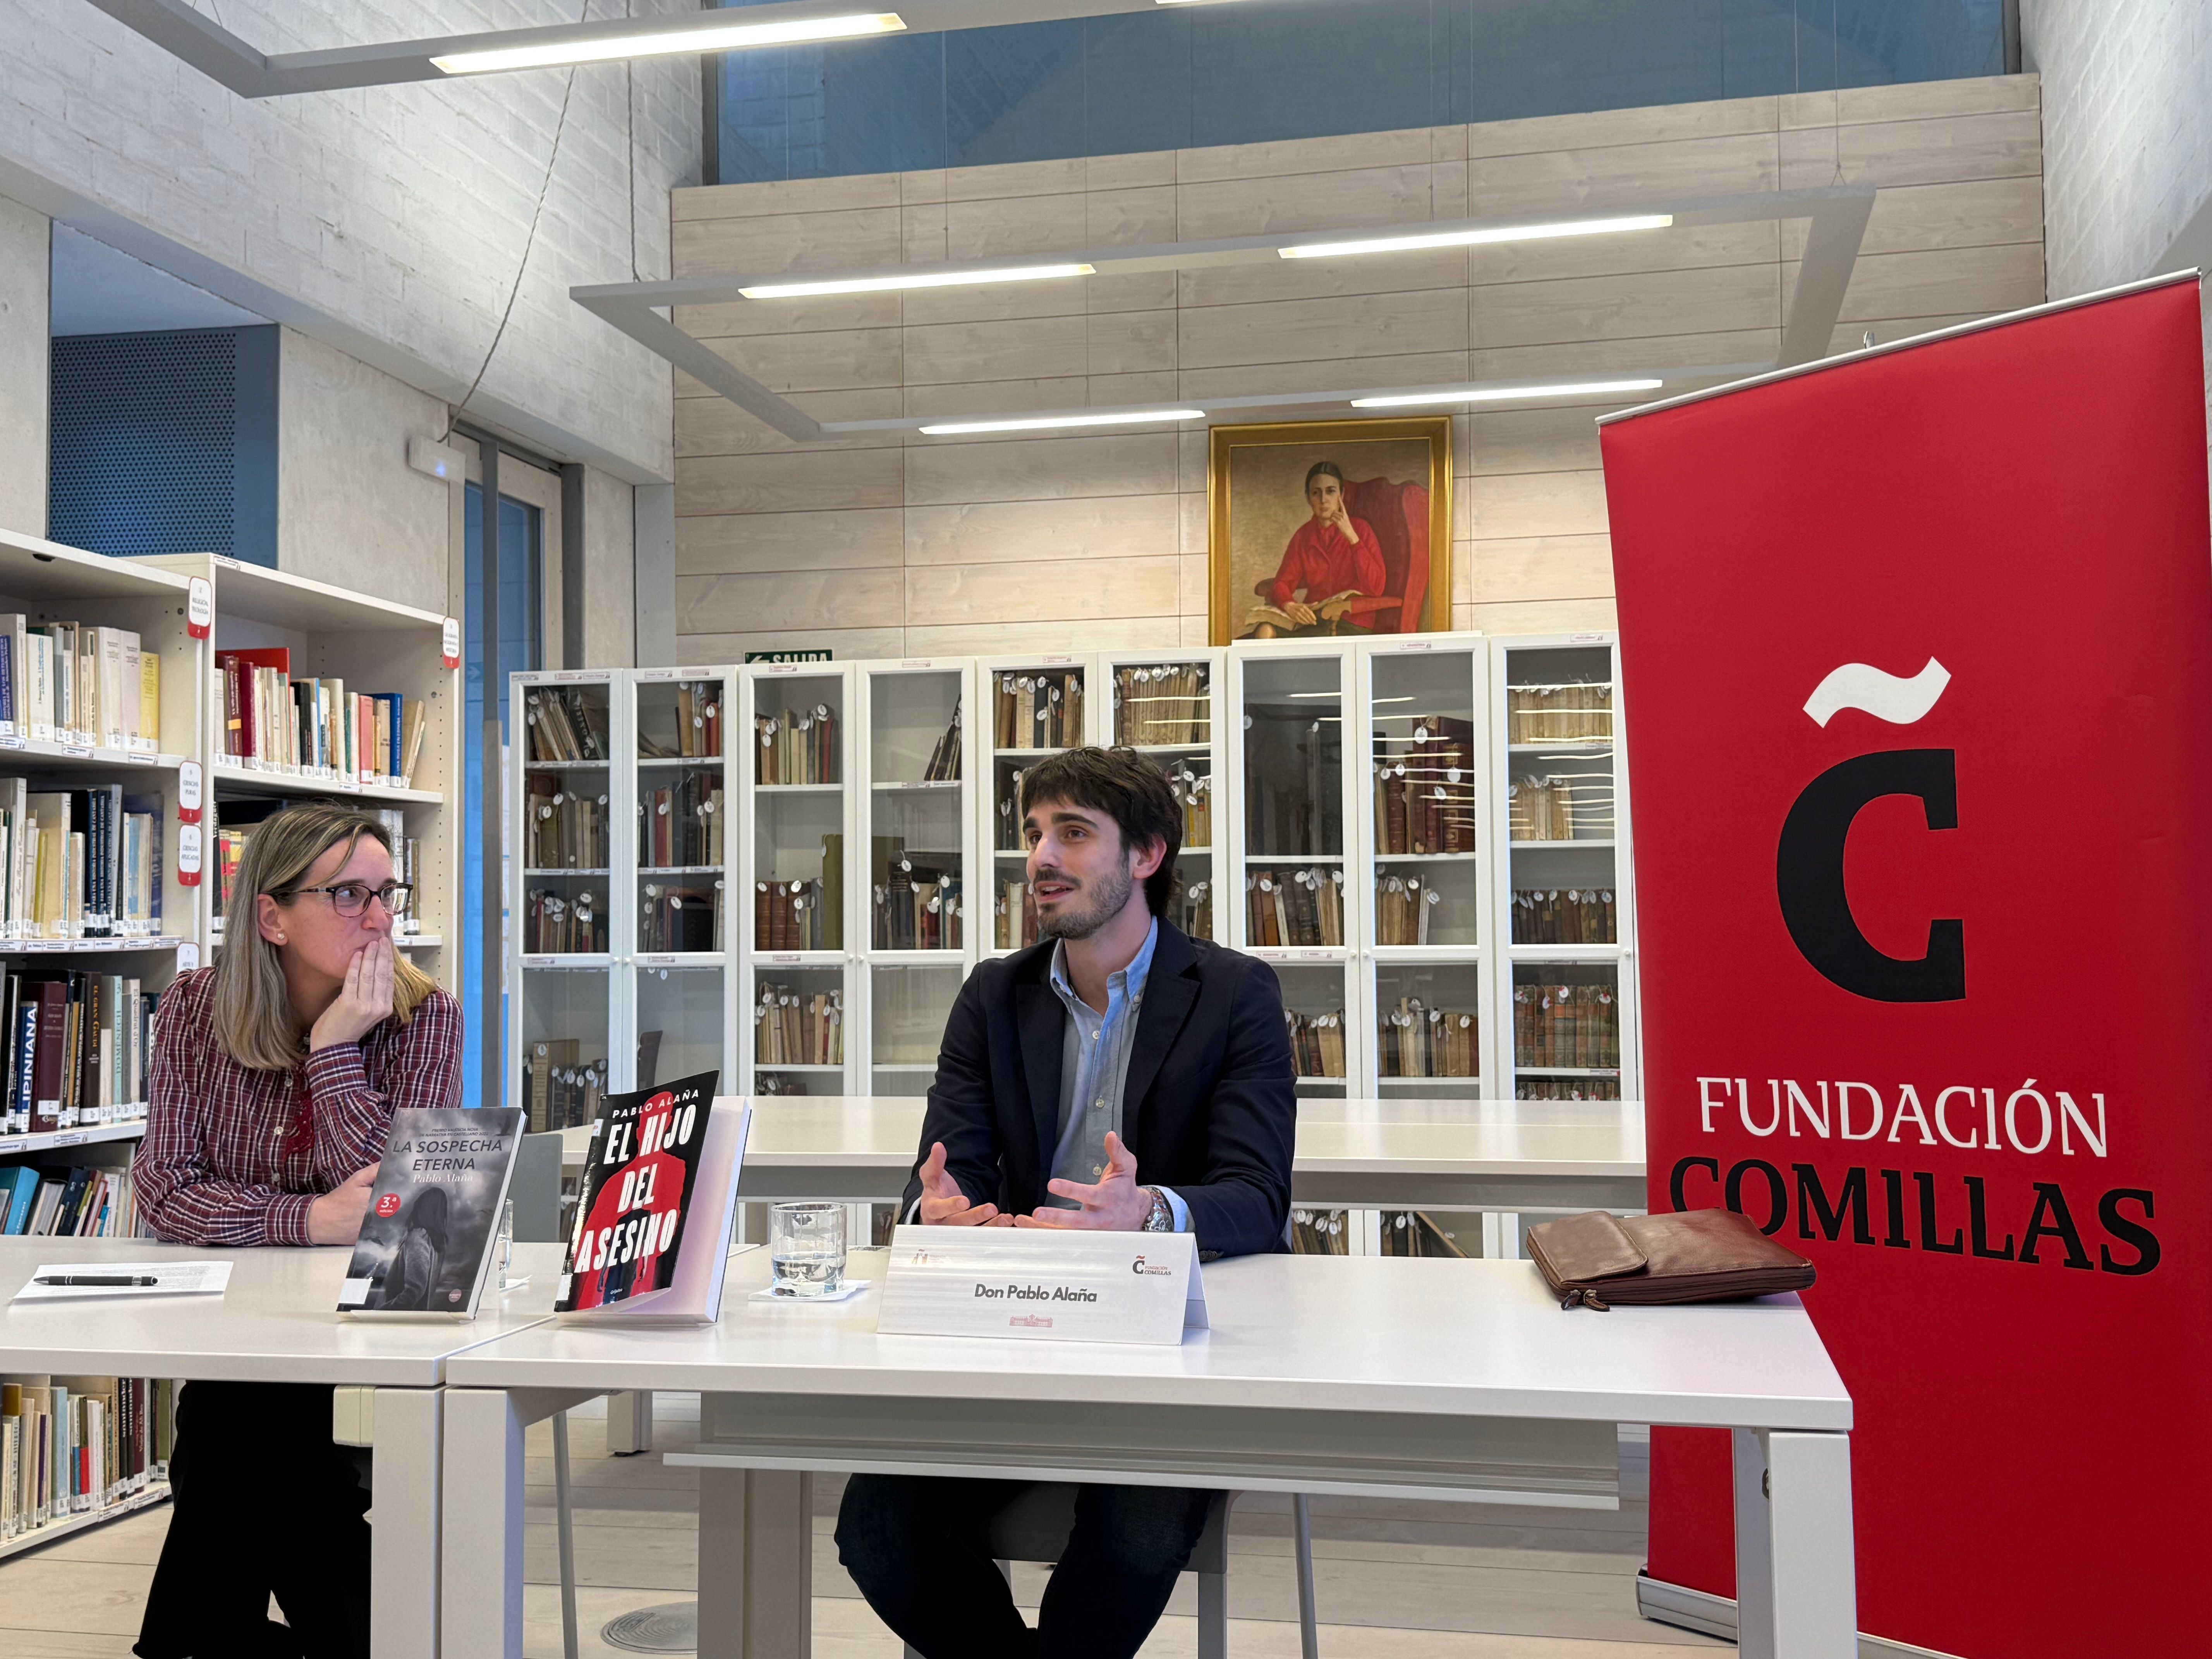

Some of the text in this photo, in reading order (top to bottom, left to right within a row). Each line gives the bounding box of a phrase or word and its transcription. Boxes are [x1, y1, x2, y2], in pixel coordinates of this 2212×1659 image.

[612, 1089, 699, 1118] PABLO ALAÑA
[1697, 1077, 2107, 1158] FUNDACIÓN
[392, 1139, 503, 1153] LA SOSPECHA
[603, 1104, 696, 1164] EL HIJO
[412, 1158, 475, 1171] ETERNA
[413, 1173, 473, 1183] Pablo Alaña
[617, 1163, 658, 1213] DEL
[1669, 1156, 2162, 1276] COMILLAS
[574, 1209, 677, 1273] ASESINO
[974, 1283, 1097, 1302] Don Pablo Alaña
